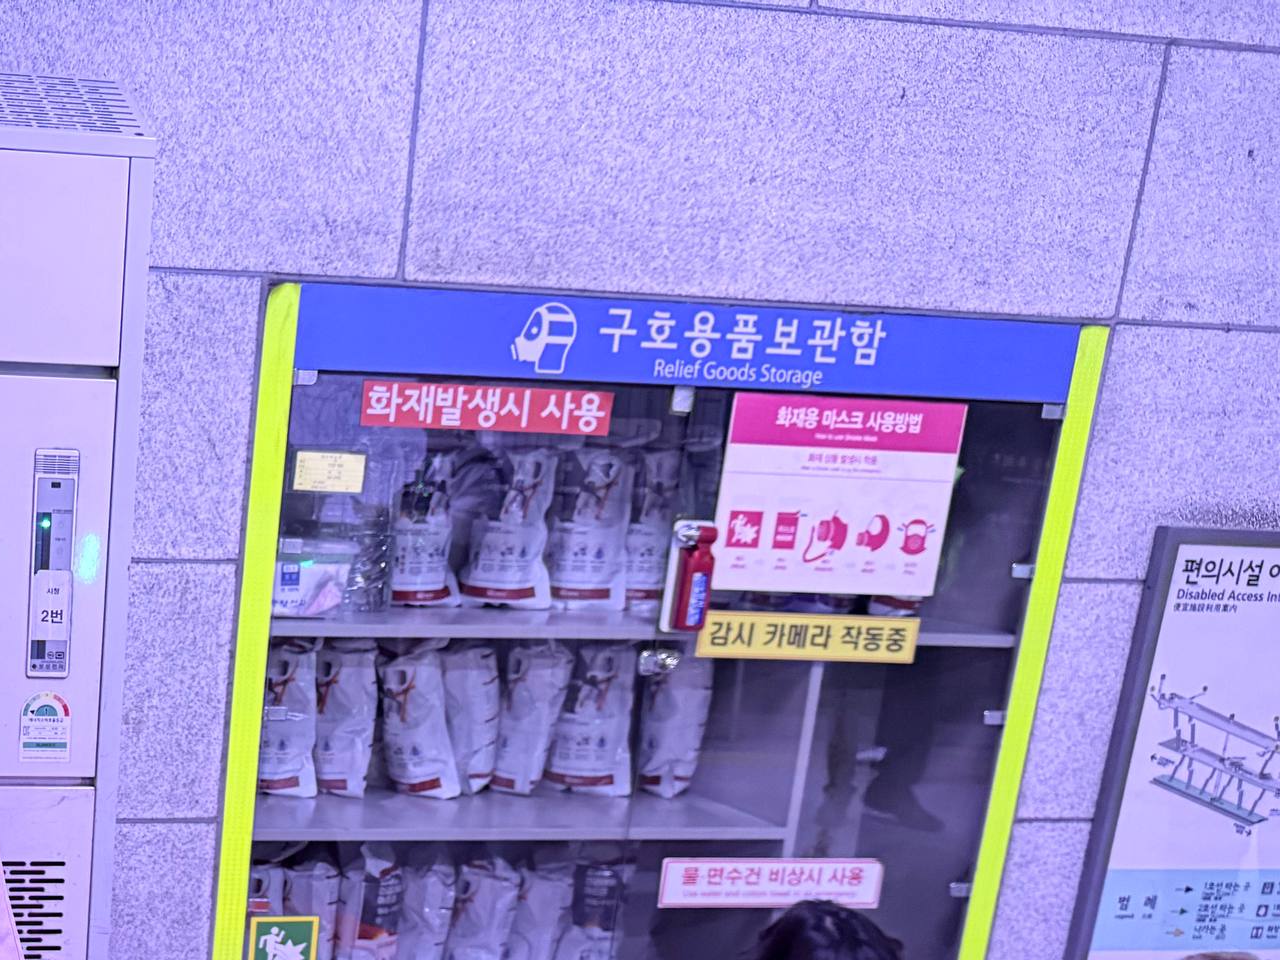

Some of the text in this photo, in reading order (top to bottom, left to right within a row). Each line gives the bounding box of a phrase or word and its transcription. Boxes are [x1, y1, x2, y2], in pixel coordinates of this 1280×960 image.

[599, 308, 886, 366] 구호용품보관함
[653, 359, 823, 388] Relief Goods Storage
[366, 383, 606, 433] 화재발생시 사용
[776, 406, 923, 434] 화재용 마스크 사용방법
[1182, 558, 1264, 587] 편의시설
[1176, 588, 1226, 601] Disabled
[1227, 590, 1264, 602] Access
[41, 609, 64, 624] 2번
[709, 621, 907, 652] 감시 카메라 작동중
[768, 867, 822, 887] 비상시
[828, 867, 865, 887] 사용
